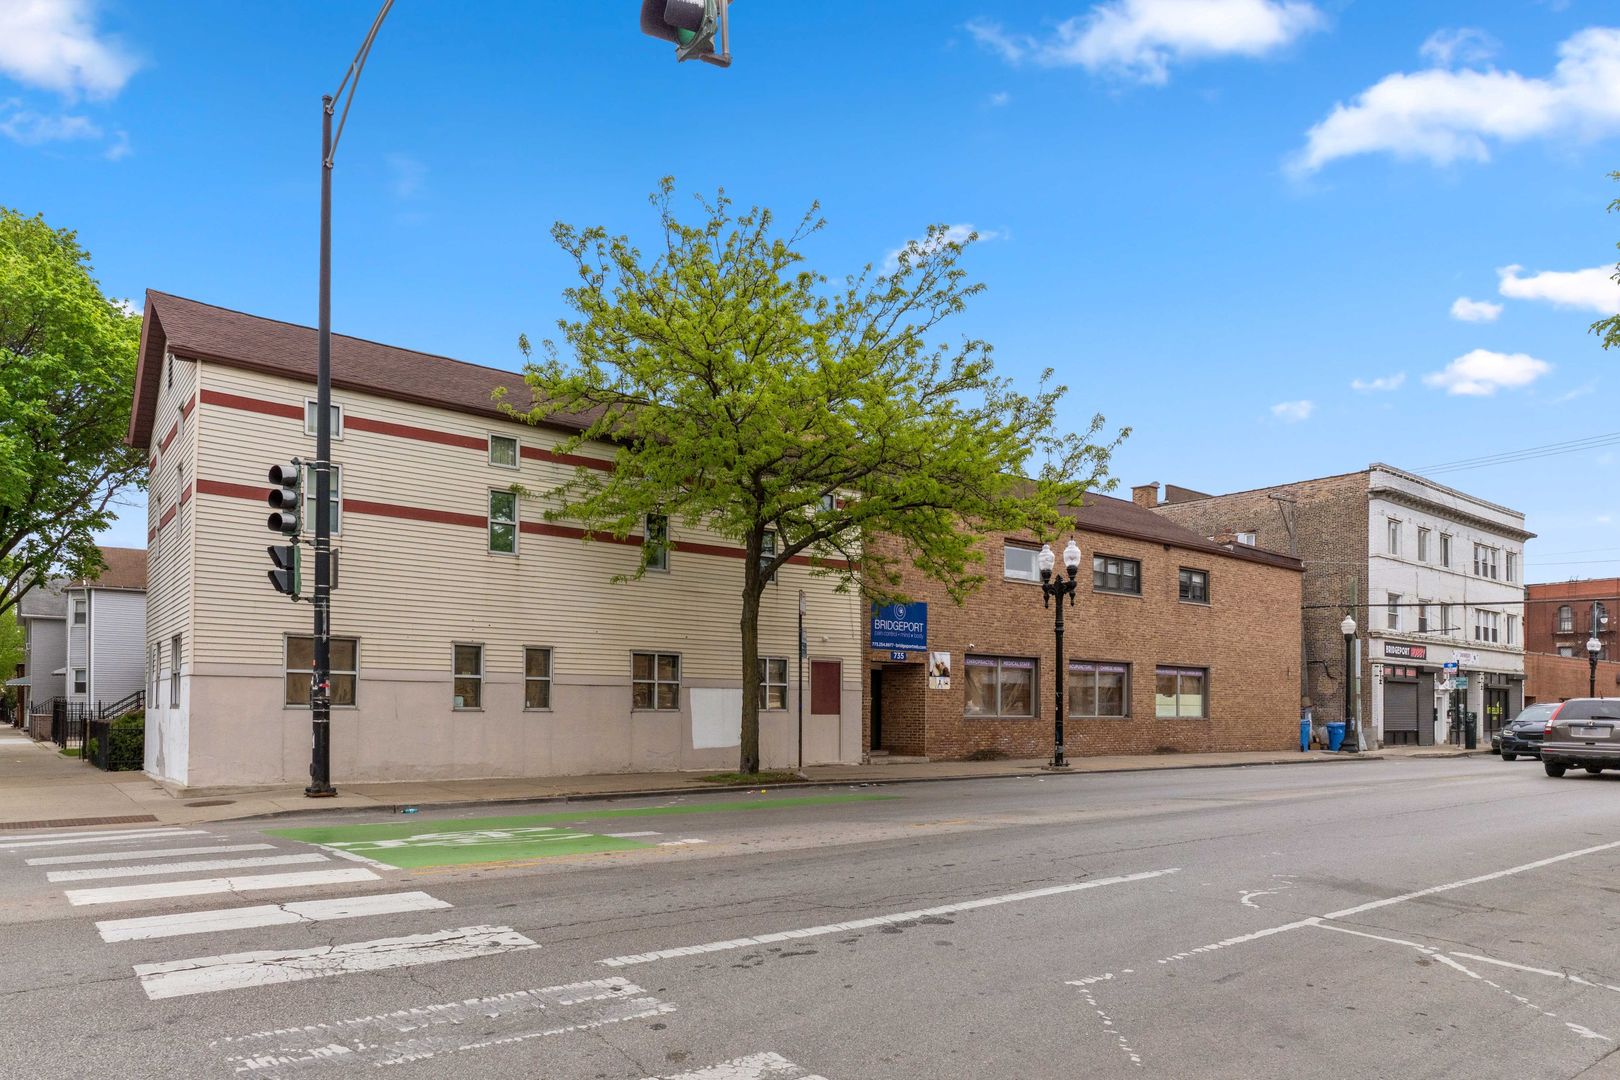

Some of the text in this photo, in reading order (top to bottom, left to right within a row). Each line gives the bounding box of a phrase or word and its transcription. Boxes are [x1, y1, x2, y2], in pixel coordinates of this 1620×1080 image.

[874, 619, 924, 633] BRIDGEPORT
[893, 652, 905, 660] 735
[1385, 645, 1410, 656] BRIDGEPORT
